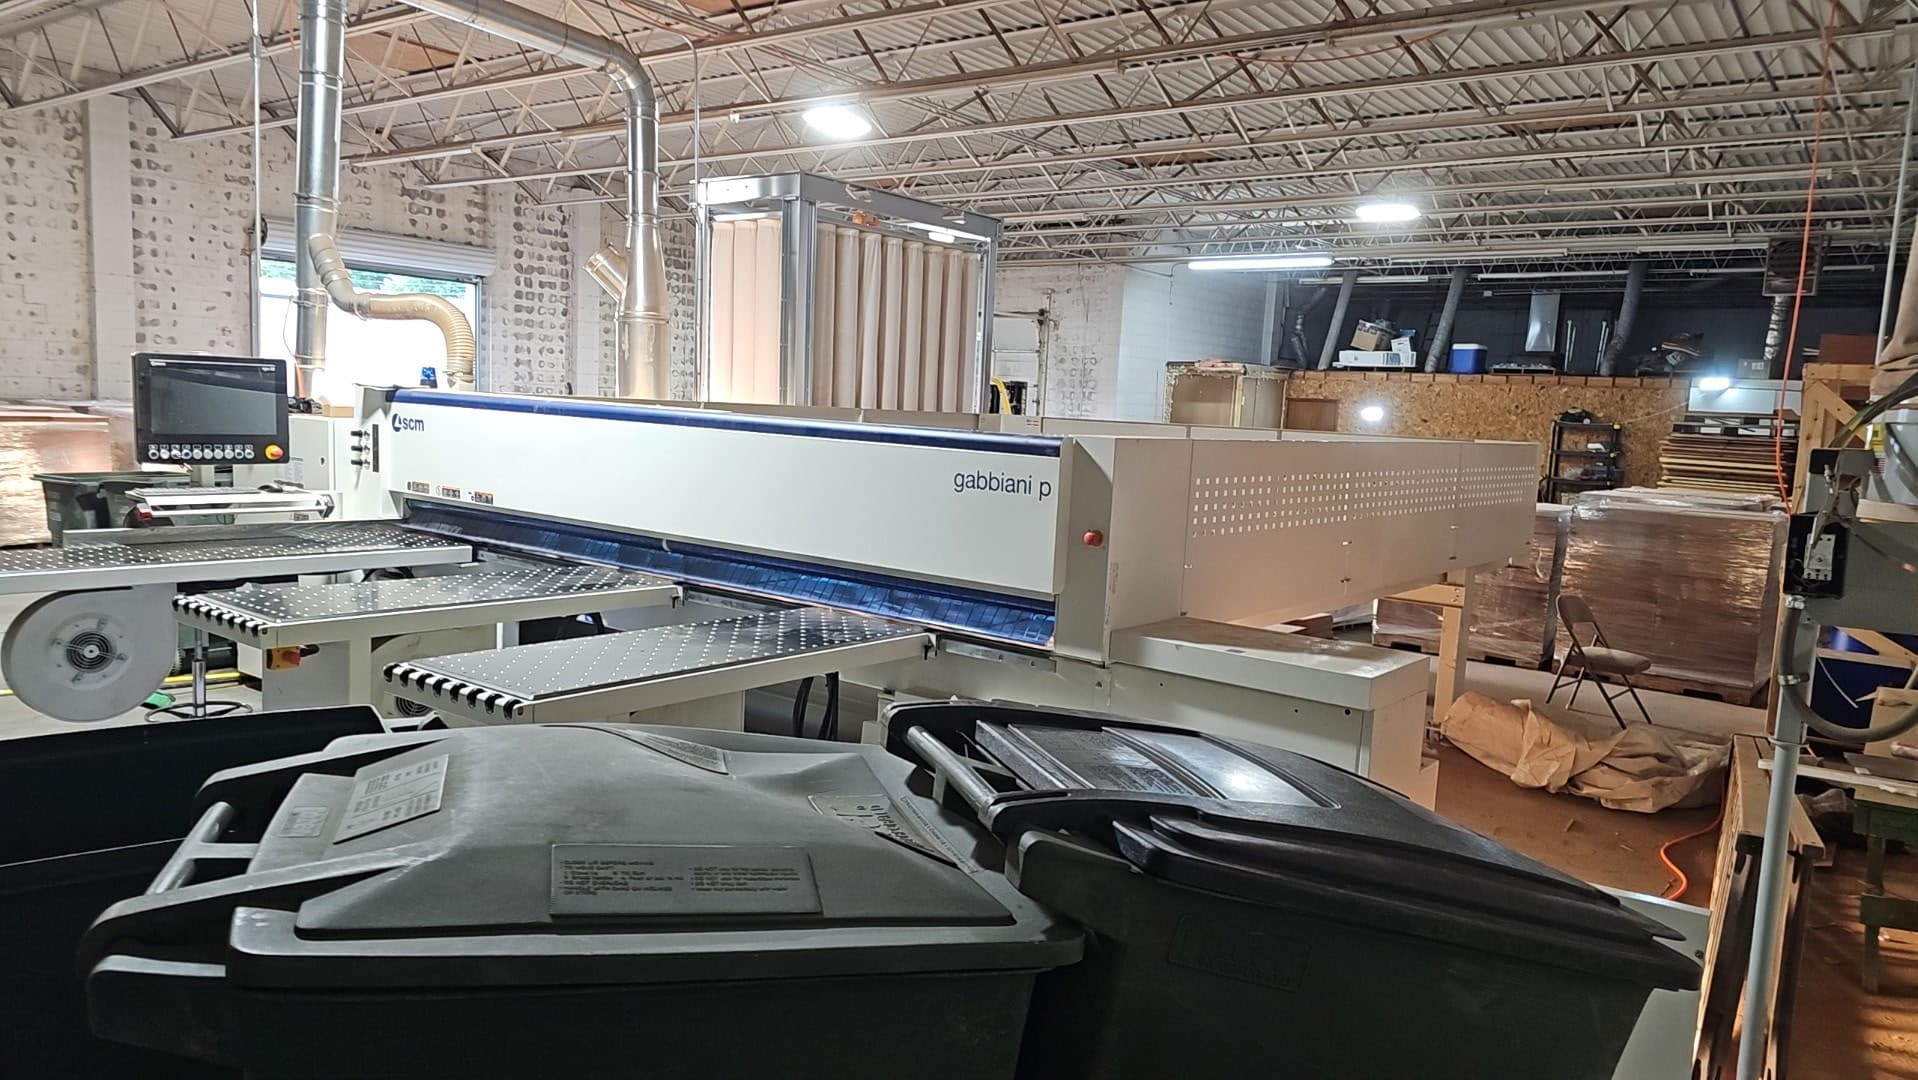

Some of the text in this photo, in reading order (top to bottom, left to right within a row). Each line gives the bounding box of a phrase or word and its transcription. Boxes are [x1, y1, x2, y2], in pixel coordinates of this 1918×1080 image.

[402, 417, 424, 432] scm
[953, 470, 1052, 501] gabbiani p
